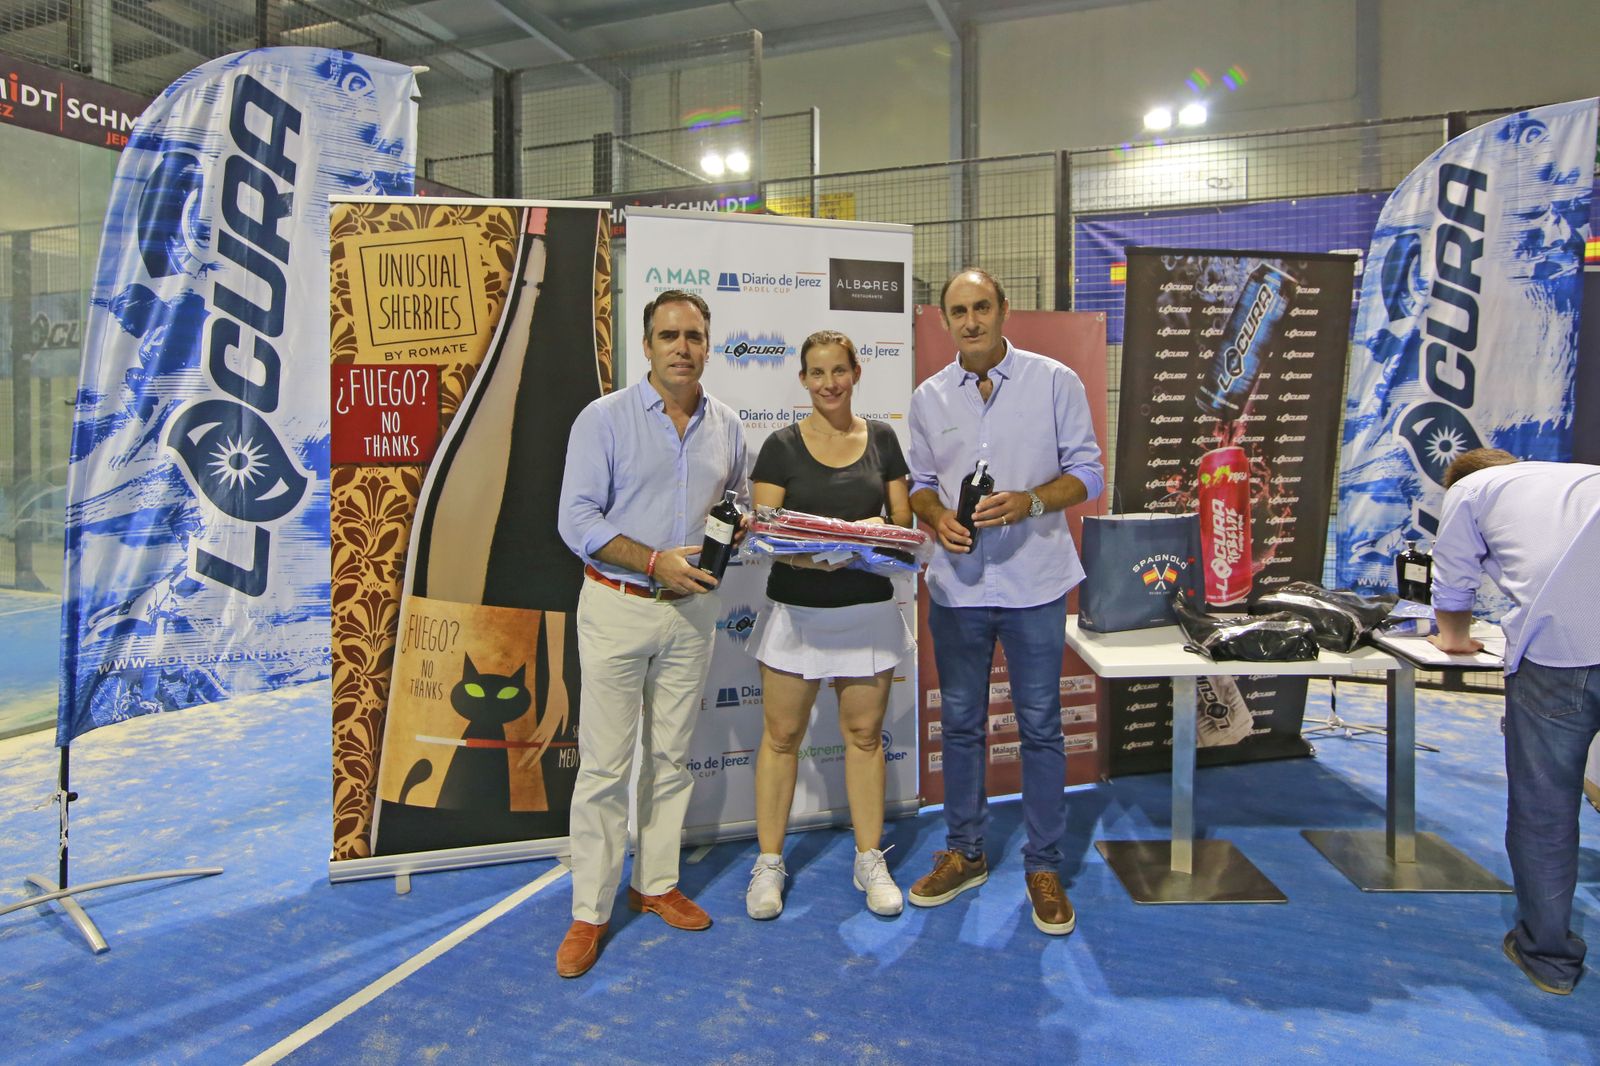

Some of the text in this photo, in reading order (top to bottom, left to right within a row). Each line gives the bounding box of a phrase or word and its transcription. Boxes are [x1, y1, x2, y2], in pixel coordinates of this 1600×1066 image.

[379, 253, 461, 288] UNUSUAL
[742, 272, 821, 289] Diario de Jerez
[836, 279, 898, 292] ALBORES
[743, 285, 770, 293] PADEL
[378, 295, 461, 330] SHERRIES
[1159, 304, 1192, 315] LOCURA
[167, 74, 307, 597] LOCURA
[1157, 326, 1190, 337] LOCURA
[1218, 283, 1274, 393] LOCURA
[1284, 328, 1317, 339] LOCURA
[384, 343, 468, 362] BY ROMATE
[725, 343, 785, 358] LOCURA
[860, 345, 873, 356] de
[875, 345, 899, 358] Jerez
[1155, 349, 1189, 360] LOCURA
[1282, 350, 1315, 360] LOCURA
[1154, 371, 1187, 382] LOCURA
[1280, 371, 1313, 381] LOCURA
[335, 368, 430, 414] ¿FUEGO?
[1278, 392, 1310, 402] LOCURA
[1152, 393, 1185, 403] LOCURA
[739, 409, 777, 421] Diario
[780, 409, 790, 421] de
[1150, 414, 1184, 425] LOCURA
[1276, 413, 1308, 423] LOCURA
[381, 411, 400, 434] NO
[1149, 436, 1182, 446] LOCURA
[1274, 434, 1306, 444] LOCURA
[364, 435, 419, 457] THANKS
[1211, 499, 1232, 592] LOCURA
[1132, 554, 1187, 573] SPAGNOLO
[401, 614, 460, 655] ¿FUEGO?
[421, 659, 433, 677] NO
[410, 678, 443, 701] THANKS
[704, 756, 719, 770] de
[721, 755, 750, 770] Jerez
